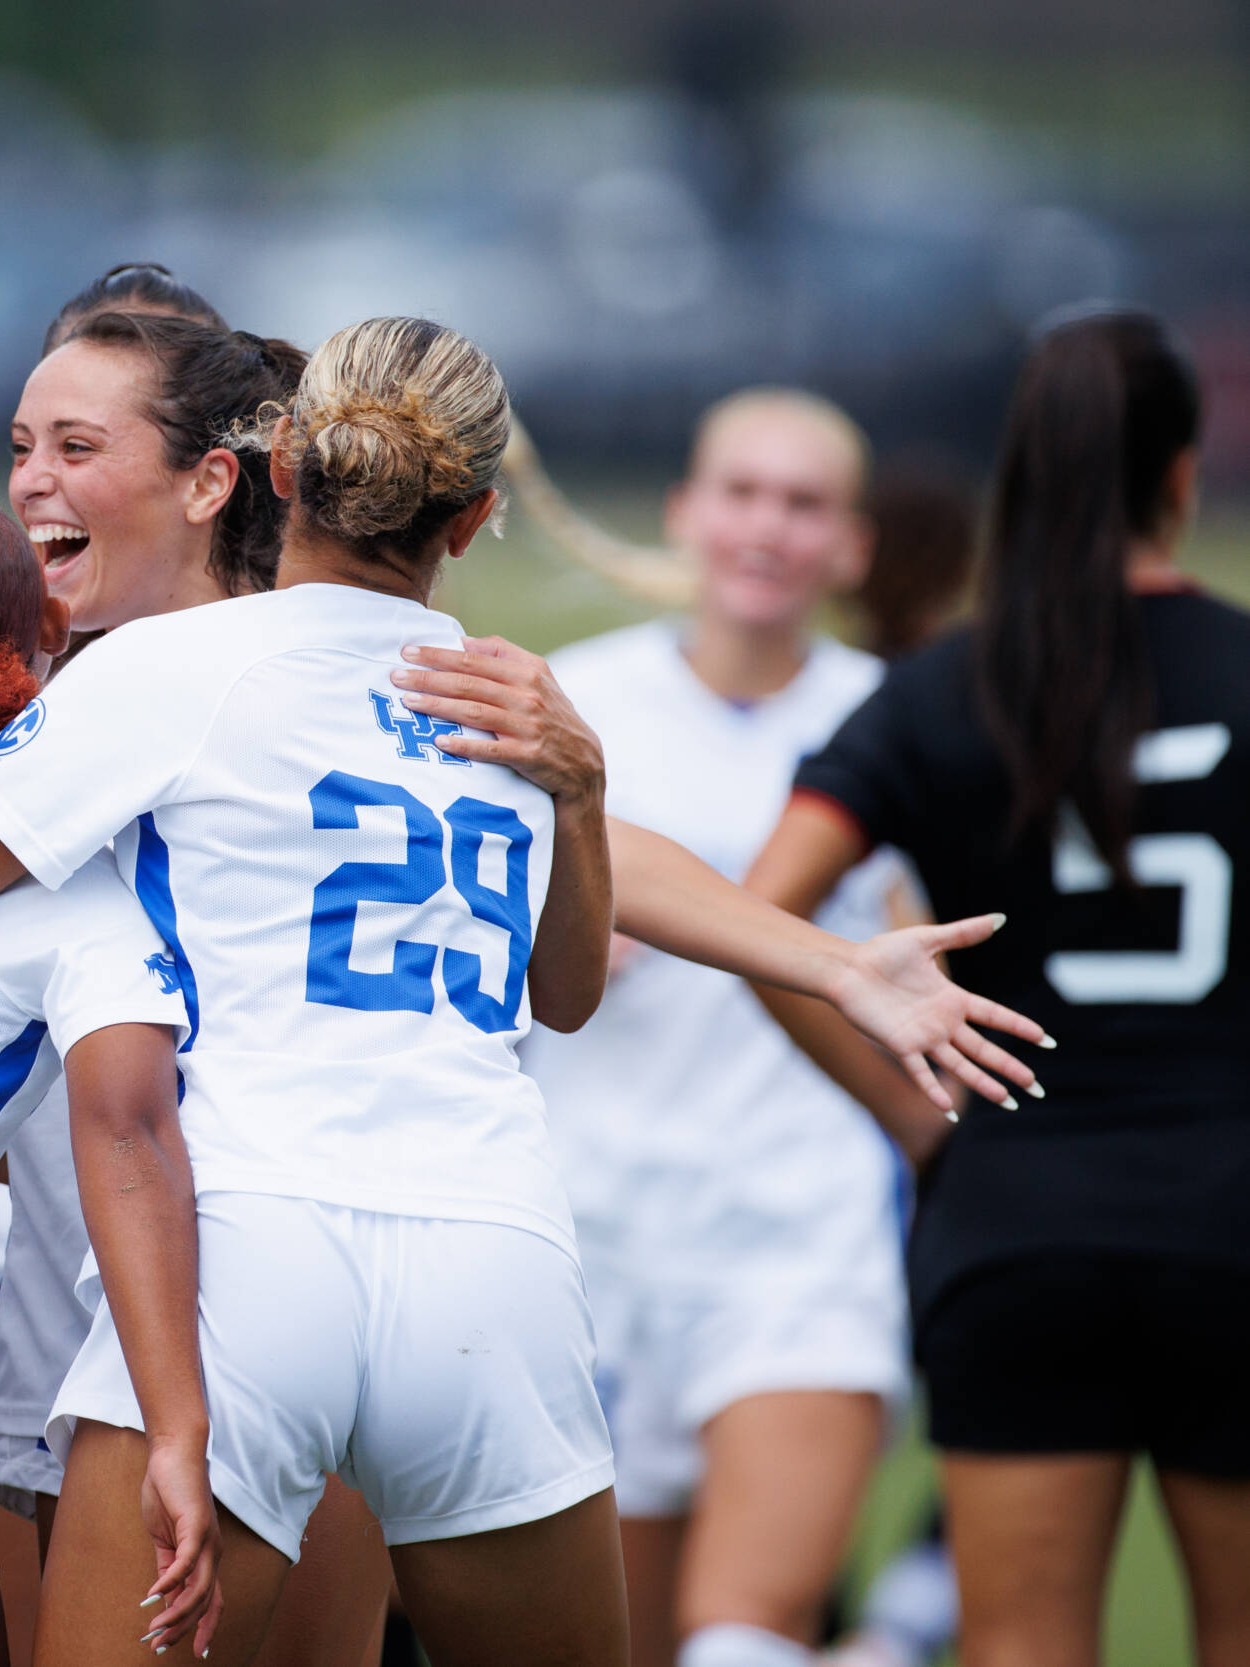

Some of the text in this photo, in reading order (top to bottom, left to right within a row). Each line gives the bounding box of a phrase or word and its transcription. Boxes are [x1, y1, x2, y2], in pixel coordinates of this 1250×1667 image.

[368, 689, 472, 767] UK
[306, 770, 534, 1034] 29
[1044, 722, 1233, 1005] 5
